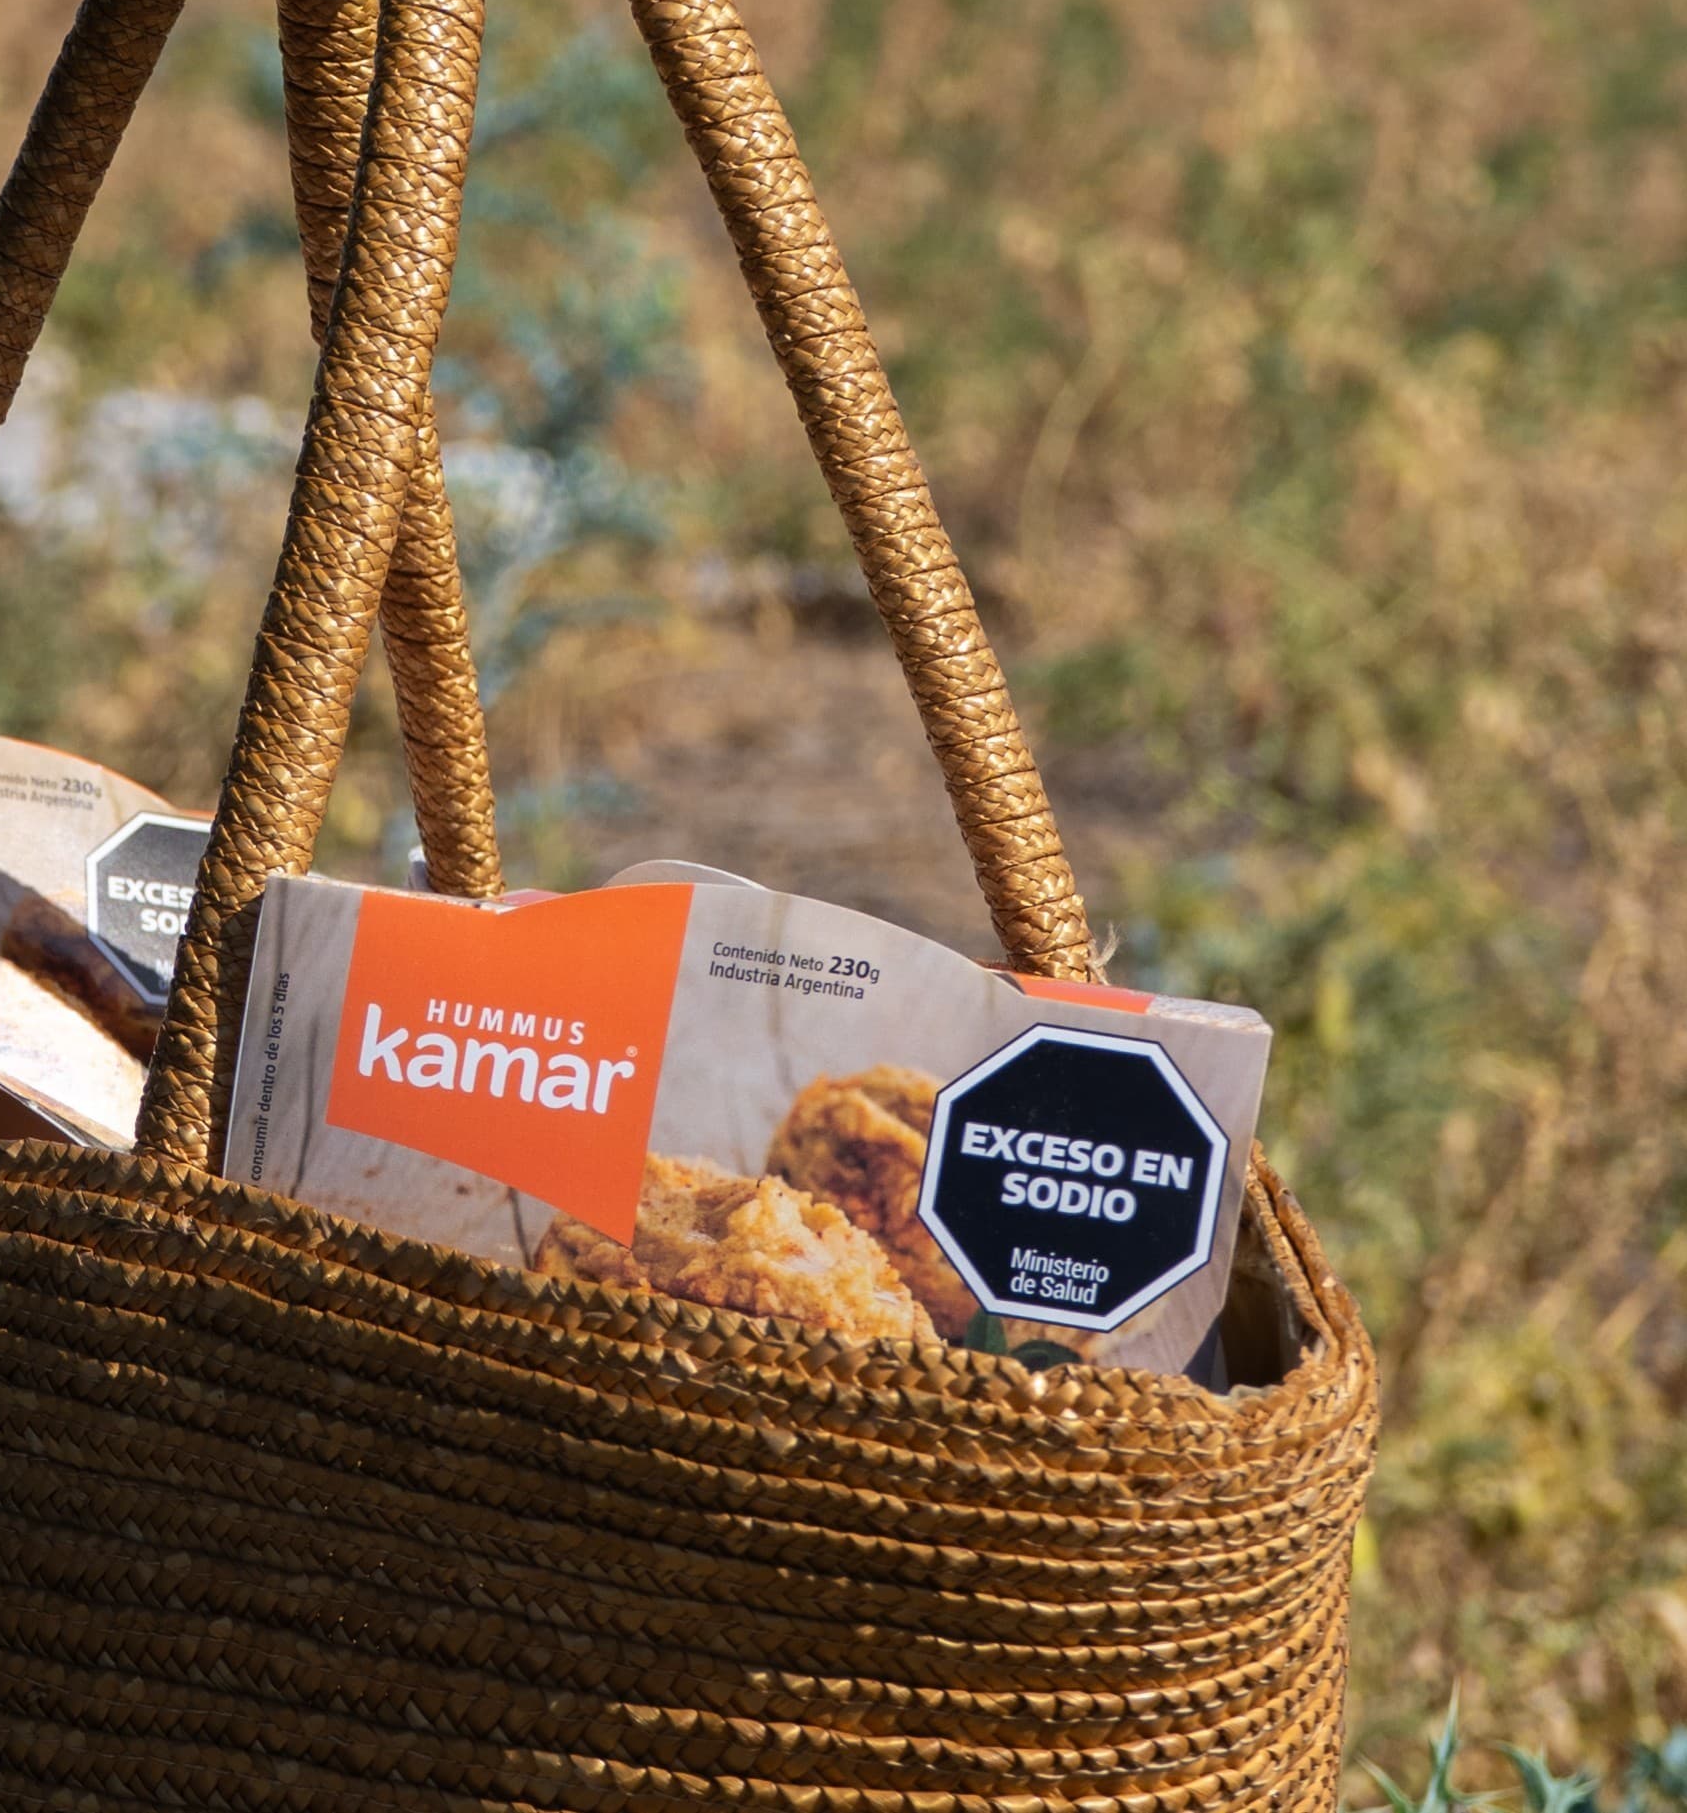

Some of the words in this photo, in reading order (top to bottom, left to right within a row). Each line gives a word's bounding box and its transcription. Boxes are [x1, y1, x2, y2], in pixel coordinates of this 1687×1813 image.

[63, 777, 102, 799] 230g
[107, 875, 195, 910] EXCES
[140, 908, 188, 935] SO
[709, 961, 781, 986] Industria
[784, 973, 865, 1000] Argentina
[712, 941, 786, 966] Contenido
[789, 954, 824, 972] Neto
[828, 956, 881, 984] 230g
[267, 1018, 283, 1039] los
[272, 1005, 285, 1016] 5
[425, 998, 586, 1045] HUMMUS
[263, 1042, 280, 1061] de
[358, 1002, 636, 1115] kamar
[257, 1063, 277, 1113] dentro
[250, 1114, 269, 1182] consumir
[960, 1121, 1126, 1178] EXCESO
[1131, 1149, 1194, 1190] EN
[1001, 1171, 1138, 1223] SODIO
[1010, 1247, 1110, 1283] Ministerio
[1010, 1272, 1037, 1294] de
[1039, 1276, 1098, 1305] Salud
